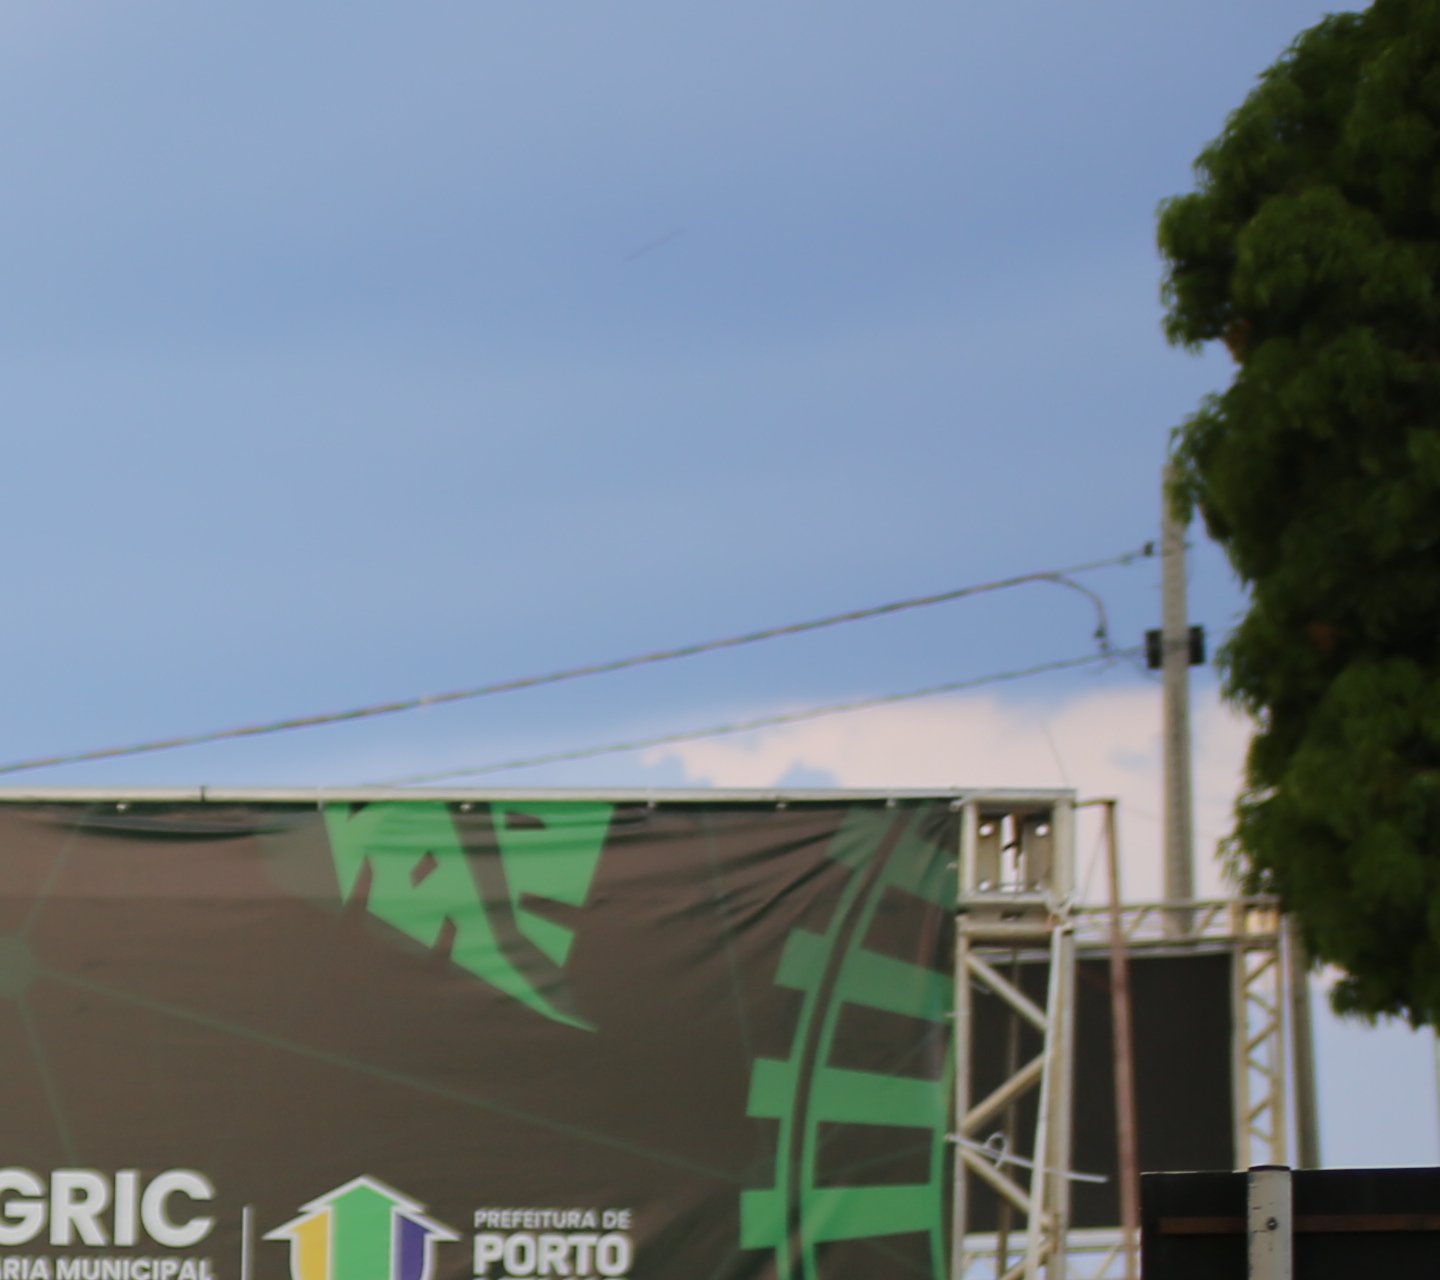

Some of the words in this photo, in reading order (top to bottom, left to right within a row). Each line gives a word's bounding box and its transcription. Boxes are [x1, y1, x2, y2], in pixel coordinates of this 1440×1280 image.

[473, 1209, 596, 1230] PREFEITURA
[602, 1208, 633, 1229] DE
[473, 1232, 634, 1277] PORTO
